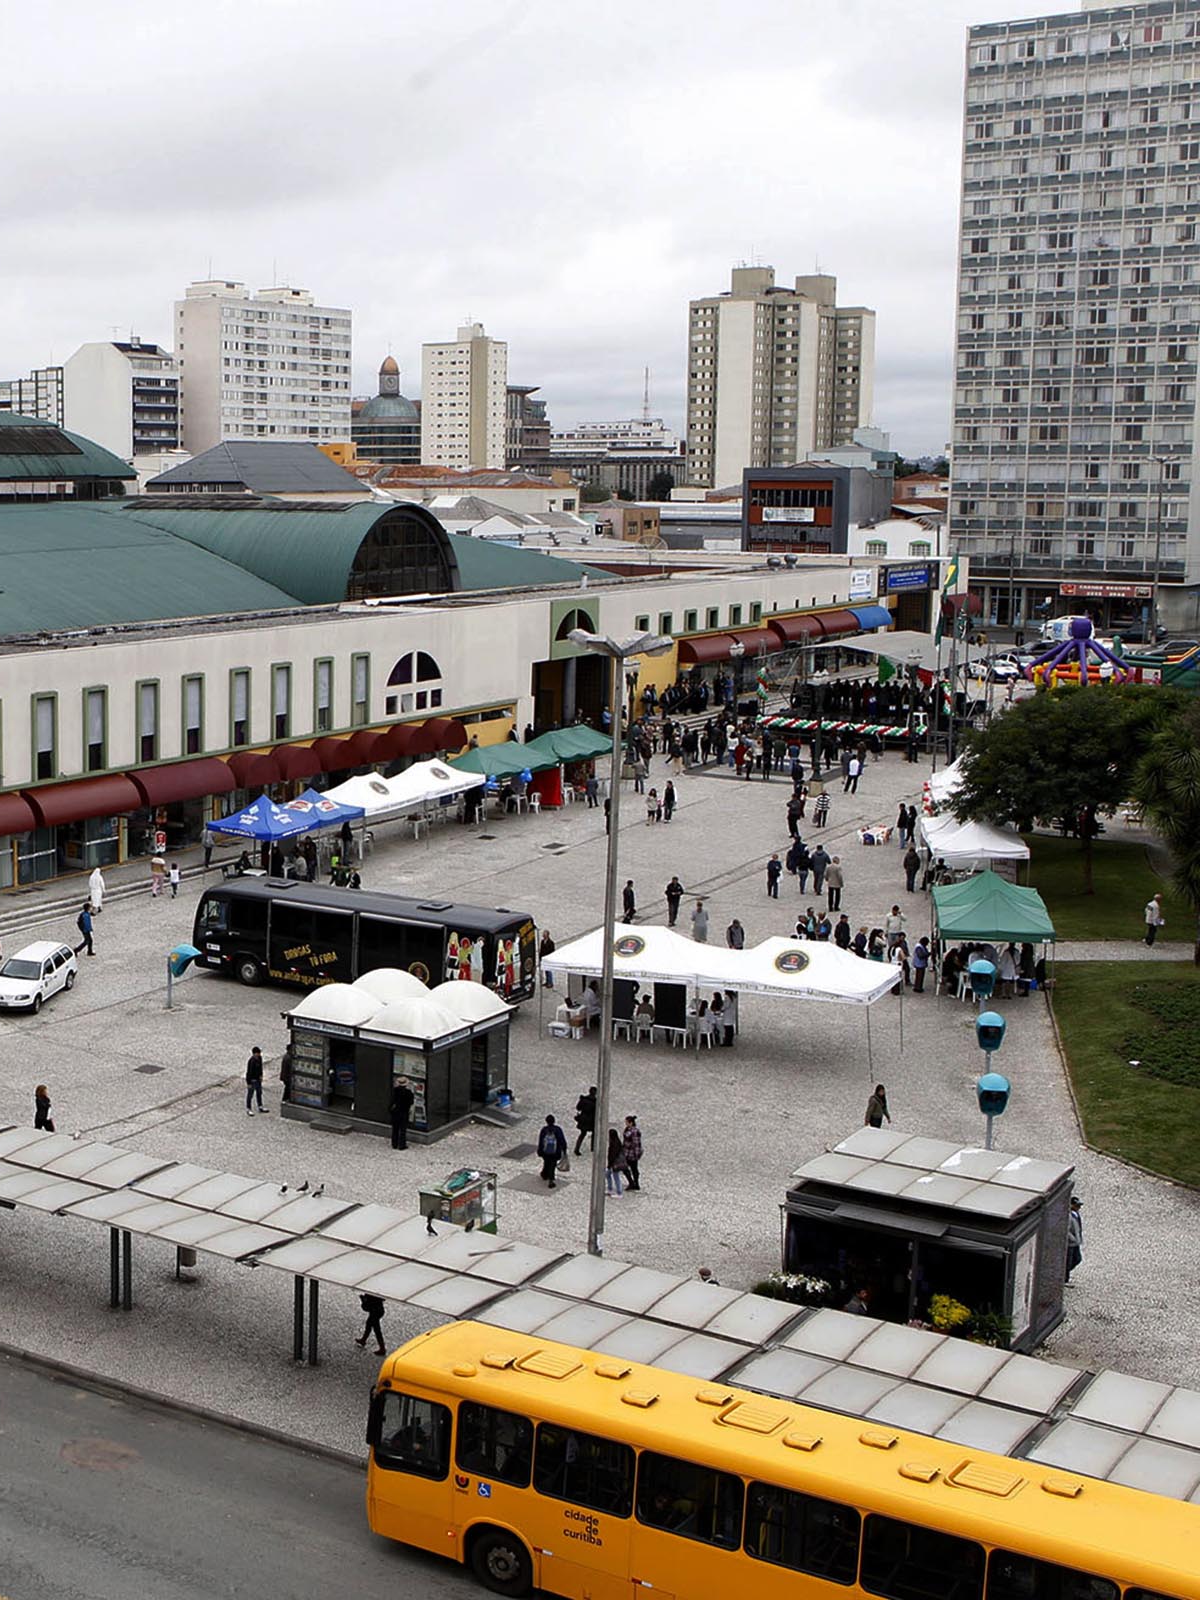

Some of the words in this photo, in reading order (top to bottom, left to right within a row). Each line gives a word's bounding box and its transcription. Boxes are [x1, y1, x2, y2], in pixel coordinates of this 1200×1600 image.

[283, 944, 311, 960] DROGAS
[319, 951, 338, 965] FORA
[564, 1509, 599, 1526] cidade
[563, 1528, 602, 1546] curitiba
[585, 1521, 599, 1536] de
